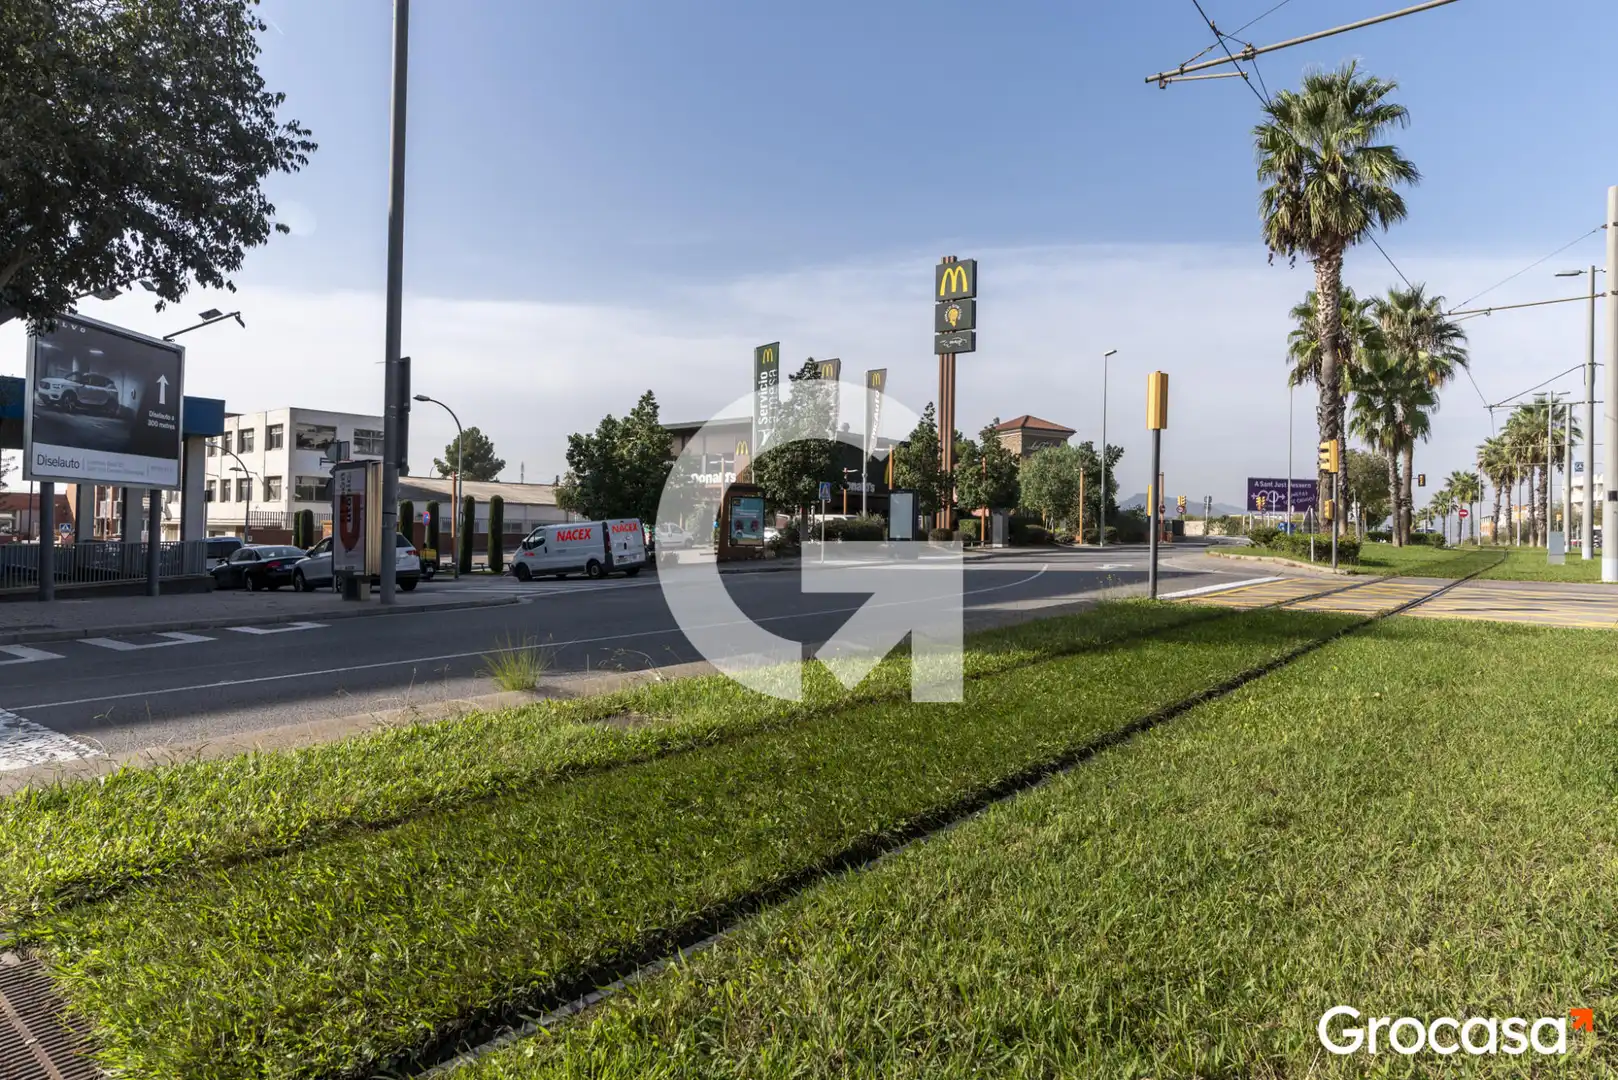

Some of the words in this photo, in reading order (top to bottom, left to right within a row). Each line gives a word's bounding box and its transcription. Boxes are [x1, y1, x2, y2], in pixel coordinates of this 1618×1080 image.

[758, 371, 768, 425] Servicio
[37, 453, 80, 469] Diselauto
[556, 527, 591, 542] NACEX
[612, 522, 638, 533] NACEX
